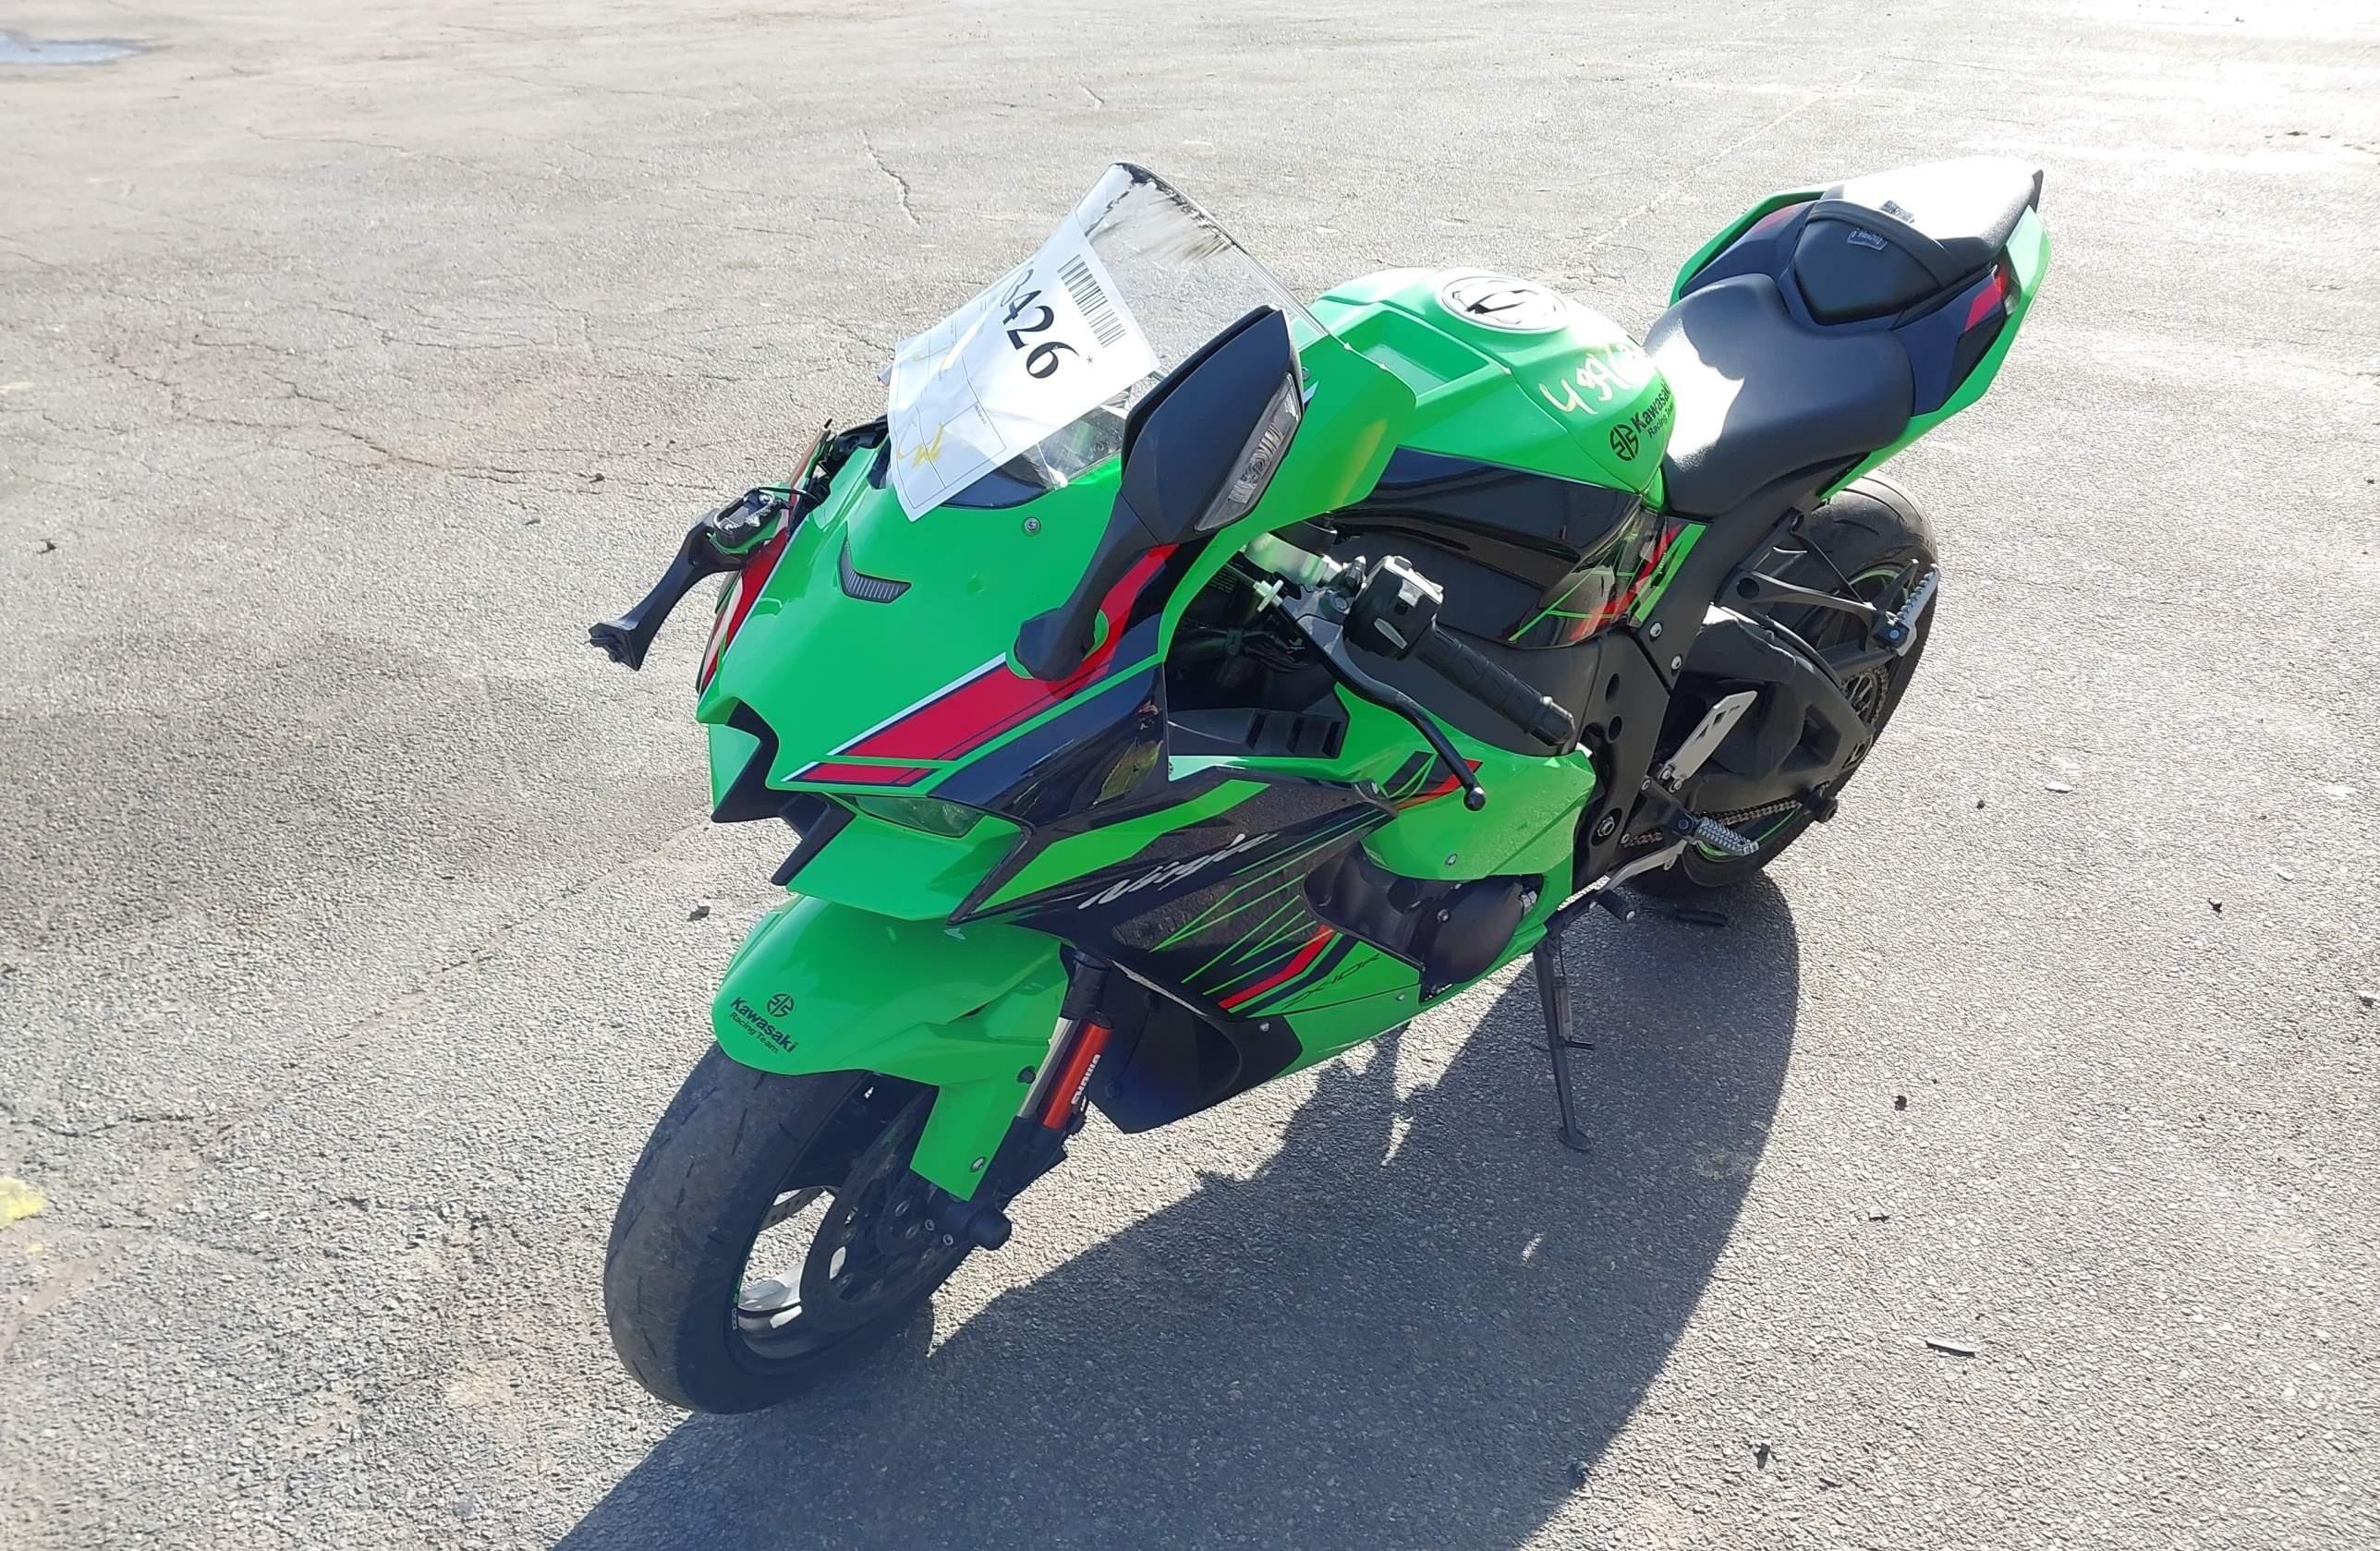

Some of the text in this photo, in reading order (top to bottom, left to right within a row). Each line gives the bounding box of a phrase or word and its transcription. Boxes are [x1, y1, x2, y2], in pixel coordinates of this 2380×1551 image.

[1076, 832, 1279, 910] Ninja
[730, 996, 798, 1053] Kawasaki
[730, 1012, 780, 1054] Racing Team
